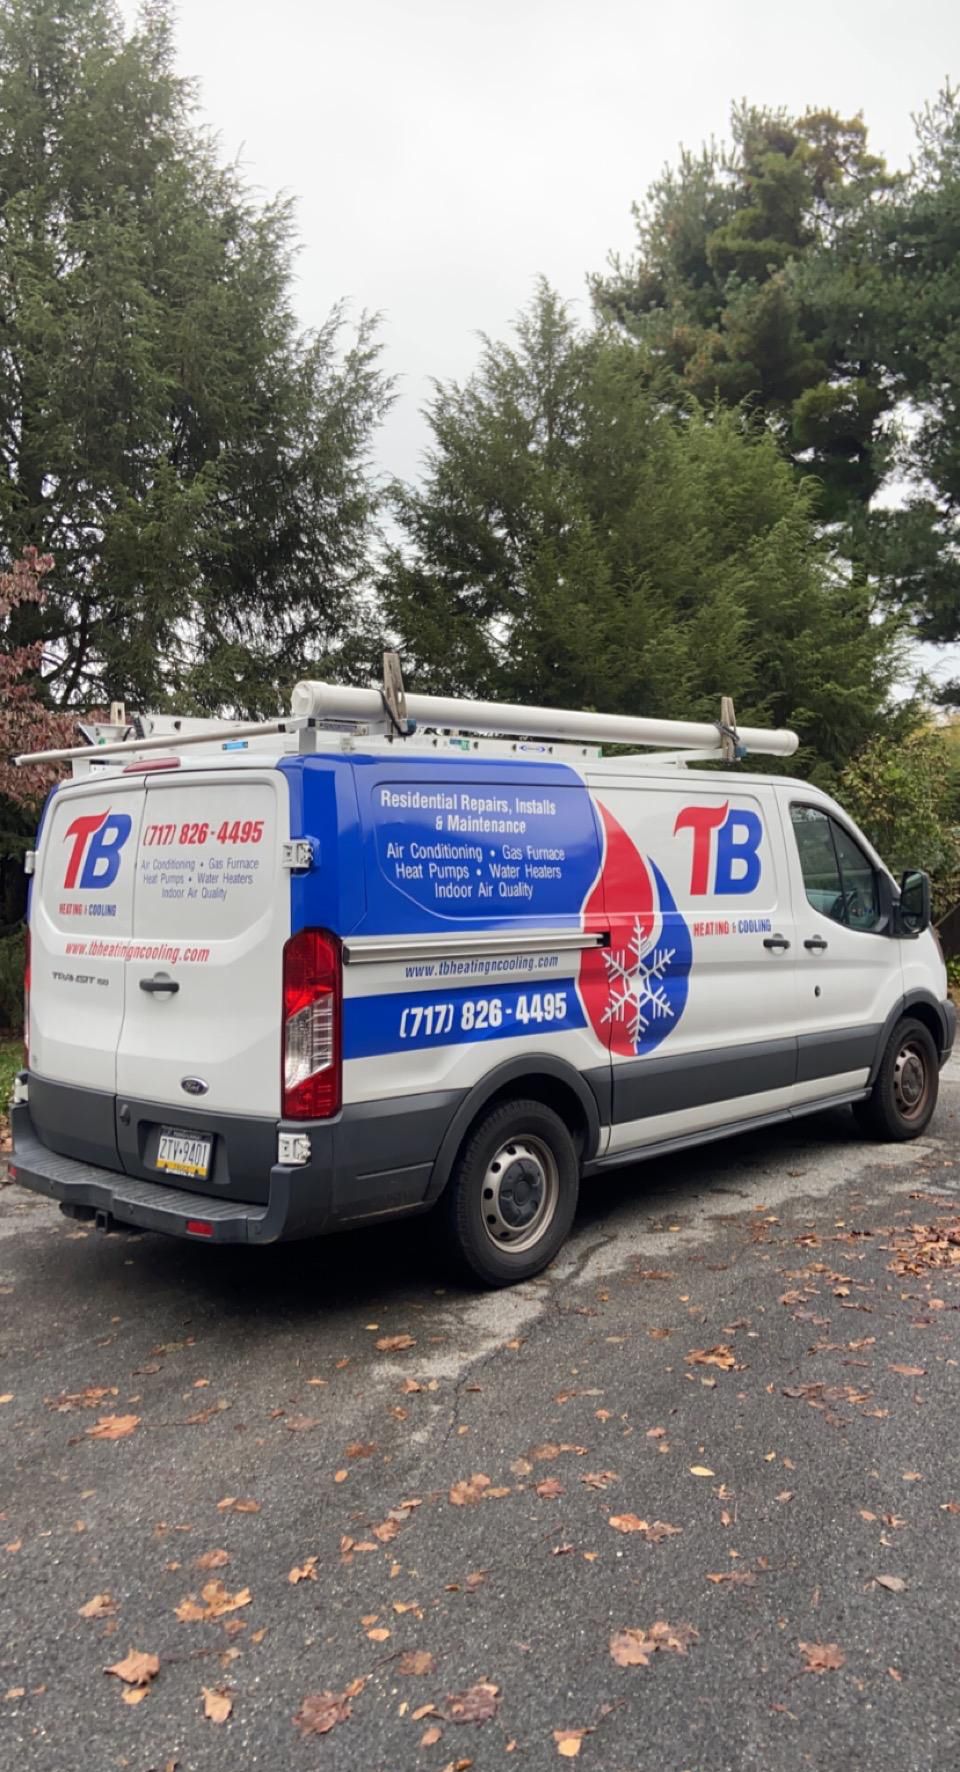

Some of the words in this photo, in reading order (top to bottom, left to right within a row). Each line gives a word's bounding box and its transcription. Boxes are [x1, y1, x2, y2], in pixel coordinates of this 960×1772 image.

[380, 789, 457, 809] Residential
[461, 793, 512, 814] Repairs,
[516, 798, 556, 815] Installs
[436, 816, 443, 830] &
[447, 815, 526, 834] Maintenance
[143, 823, 176, 846] (717)
[63, 806, 132, 888] TB
[387, 843, 403, 858] Air
[410, 843, 483, 862] Conditioning
[502, 845, 523, 859] Gas
[527, 846, 565, 861] Furnace
[673, 800, 763, 896] TB
[141, 859, 150, 870] Air
[152, 859, 195, 872] Conditioning
[208, 858, 223, 869] Gas
[226, 858, 259, 870] Furnace
[396, 863, 423, 878] Heat
[429, 863, 470, 880] Pumps
[489, 864, 520, 878] Water
[525, 864, 562, 879] Heaters
[143, 874, 158, 884] Heat
[160, 873, 184, 886] Pumps
[197, 873, 219, 884] Water
[223, 873, 253, 885] Heaters
[161, 887, 184, 898] Indoor
[187, 887, 198, 898] Air
[201, 887, 227, 901] Quality
[435, 882, 472, 898] Indoor
[478, 882, 493, 897] Air
[499, 882, 534, 900] Quality
[59, 903, 83, 915] HEATING
[89, 904, 117, 916] COOLING
[693, 920, 729, 936] HEATING
[738, 919, 771, 934] COOLING
[65, 940, 210, 963] www.tbheatingncooling.com
[405, 956, 559, 977] www.tbheatingncooling.com
[400, 1003, 454, 1038] (717)
